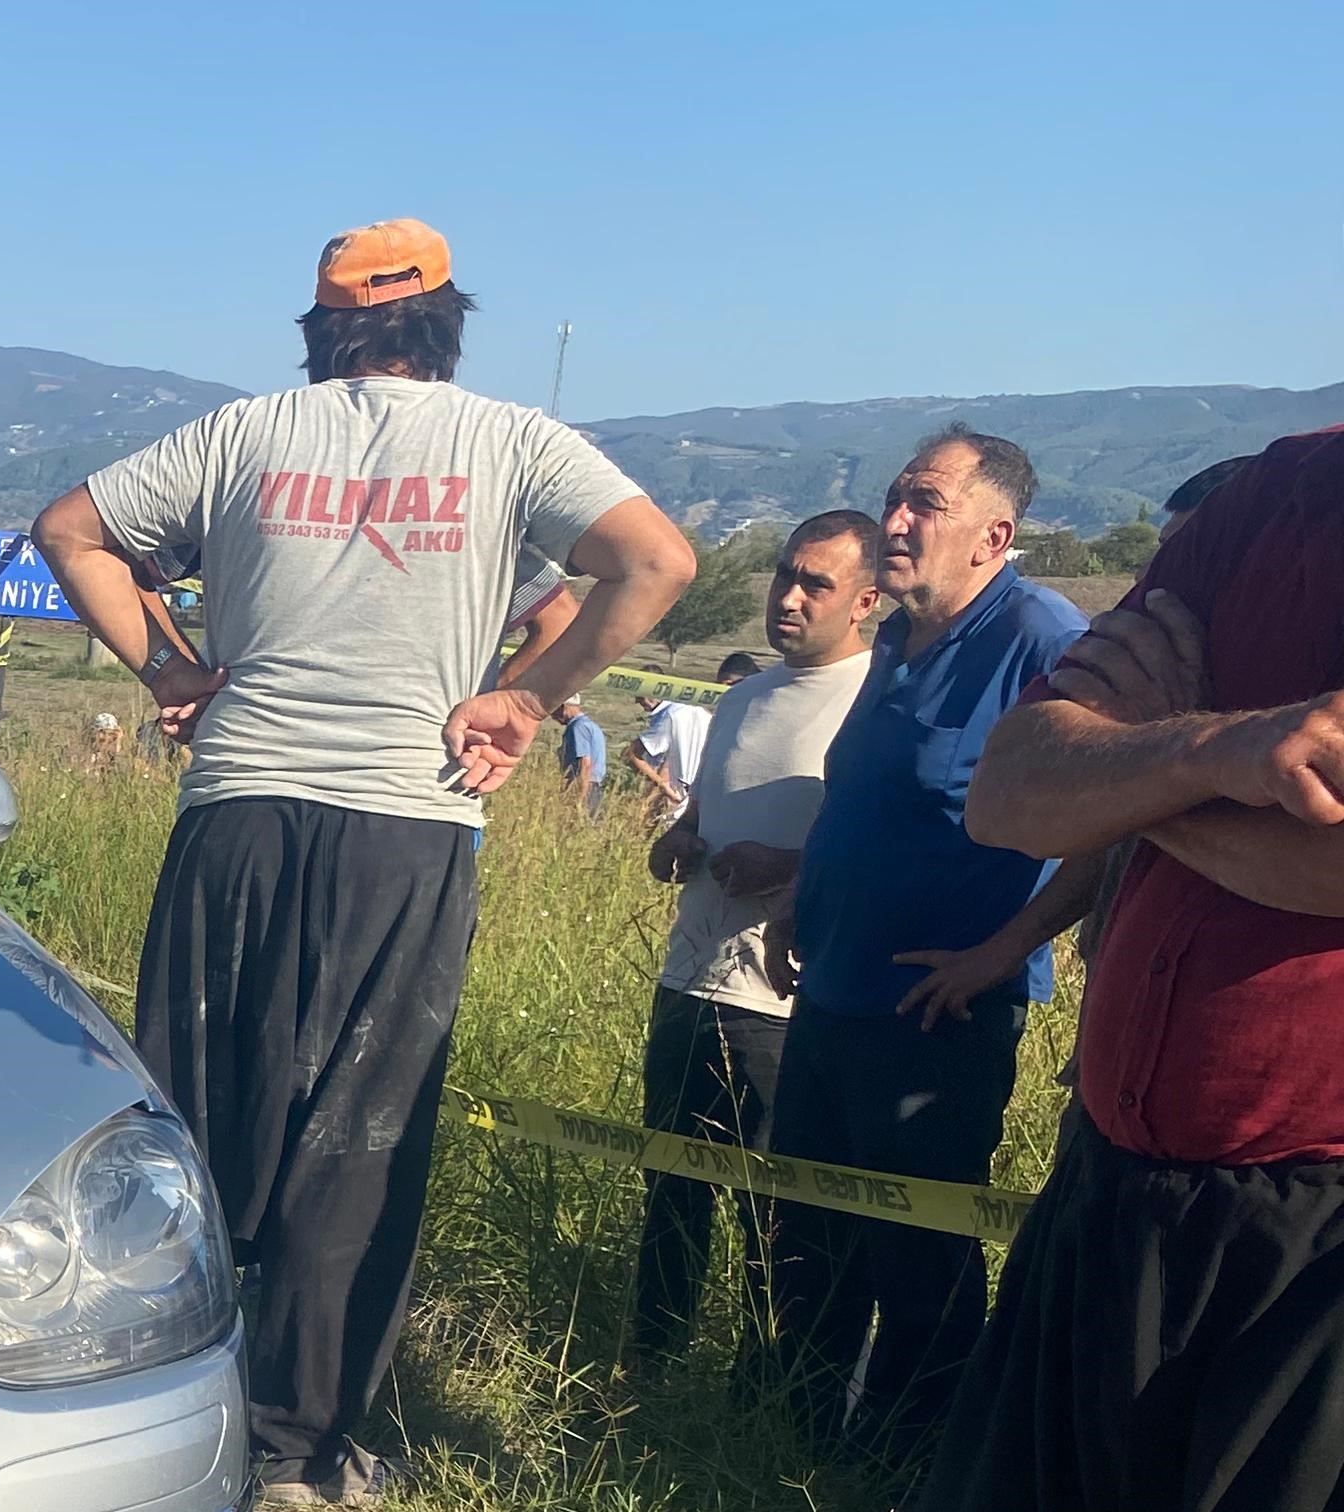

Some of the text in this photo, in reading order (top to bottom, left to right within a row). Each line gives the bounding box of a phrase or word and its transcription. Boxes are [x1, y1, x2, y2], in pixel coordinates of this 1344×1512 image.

[258, 471, 470, 525] YILMAZ
[287, 524, 311, 538] 343
[314, 526, 330, 539] 53
[402, 527, 465, 553] AKÜ
